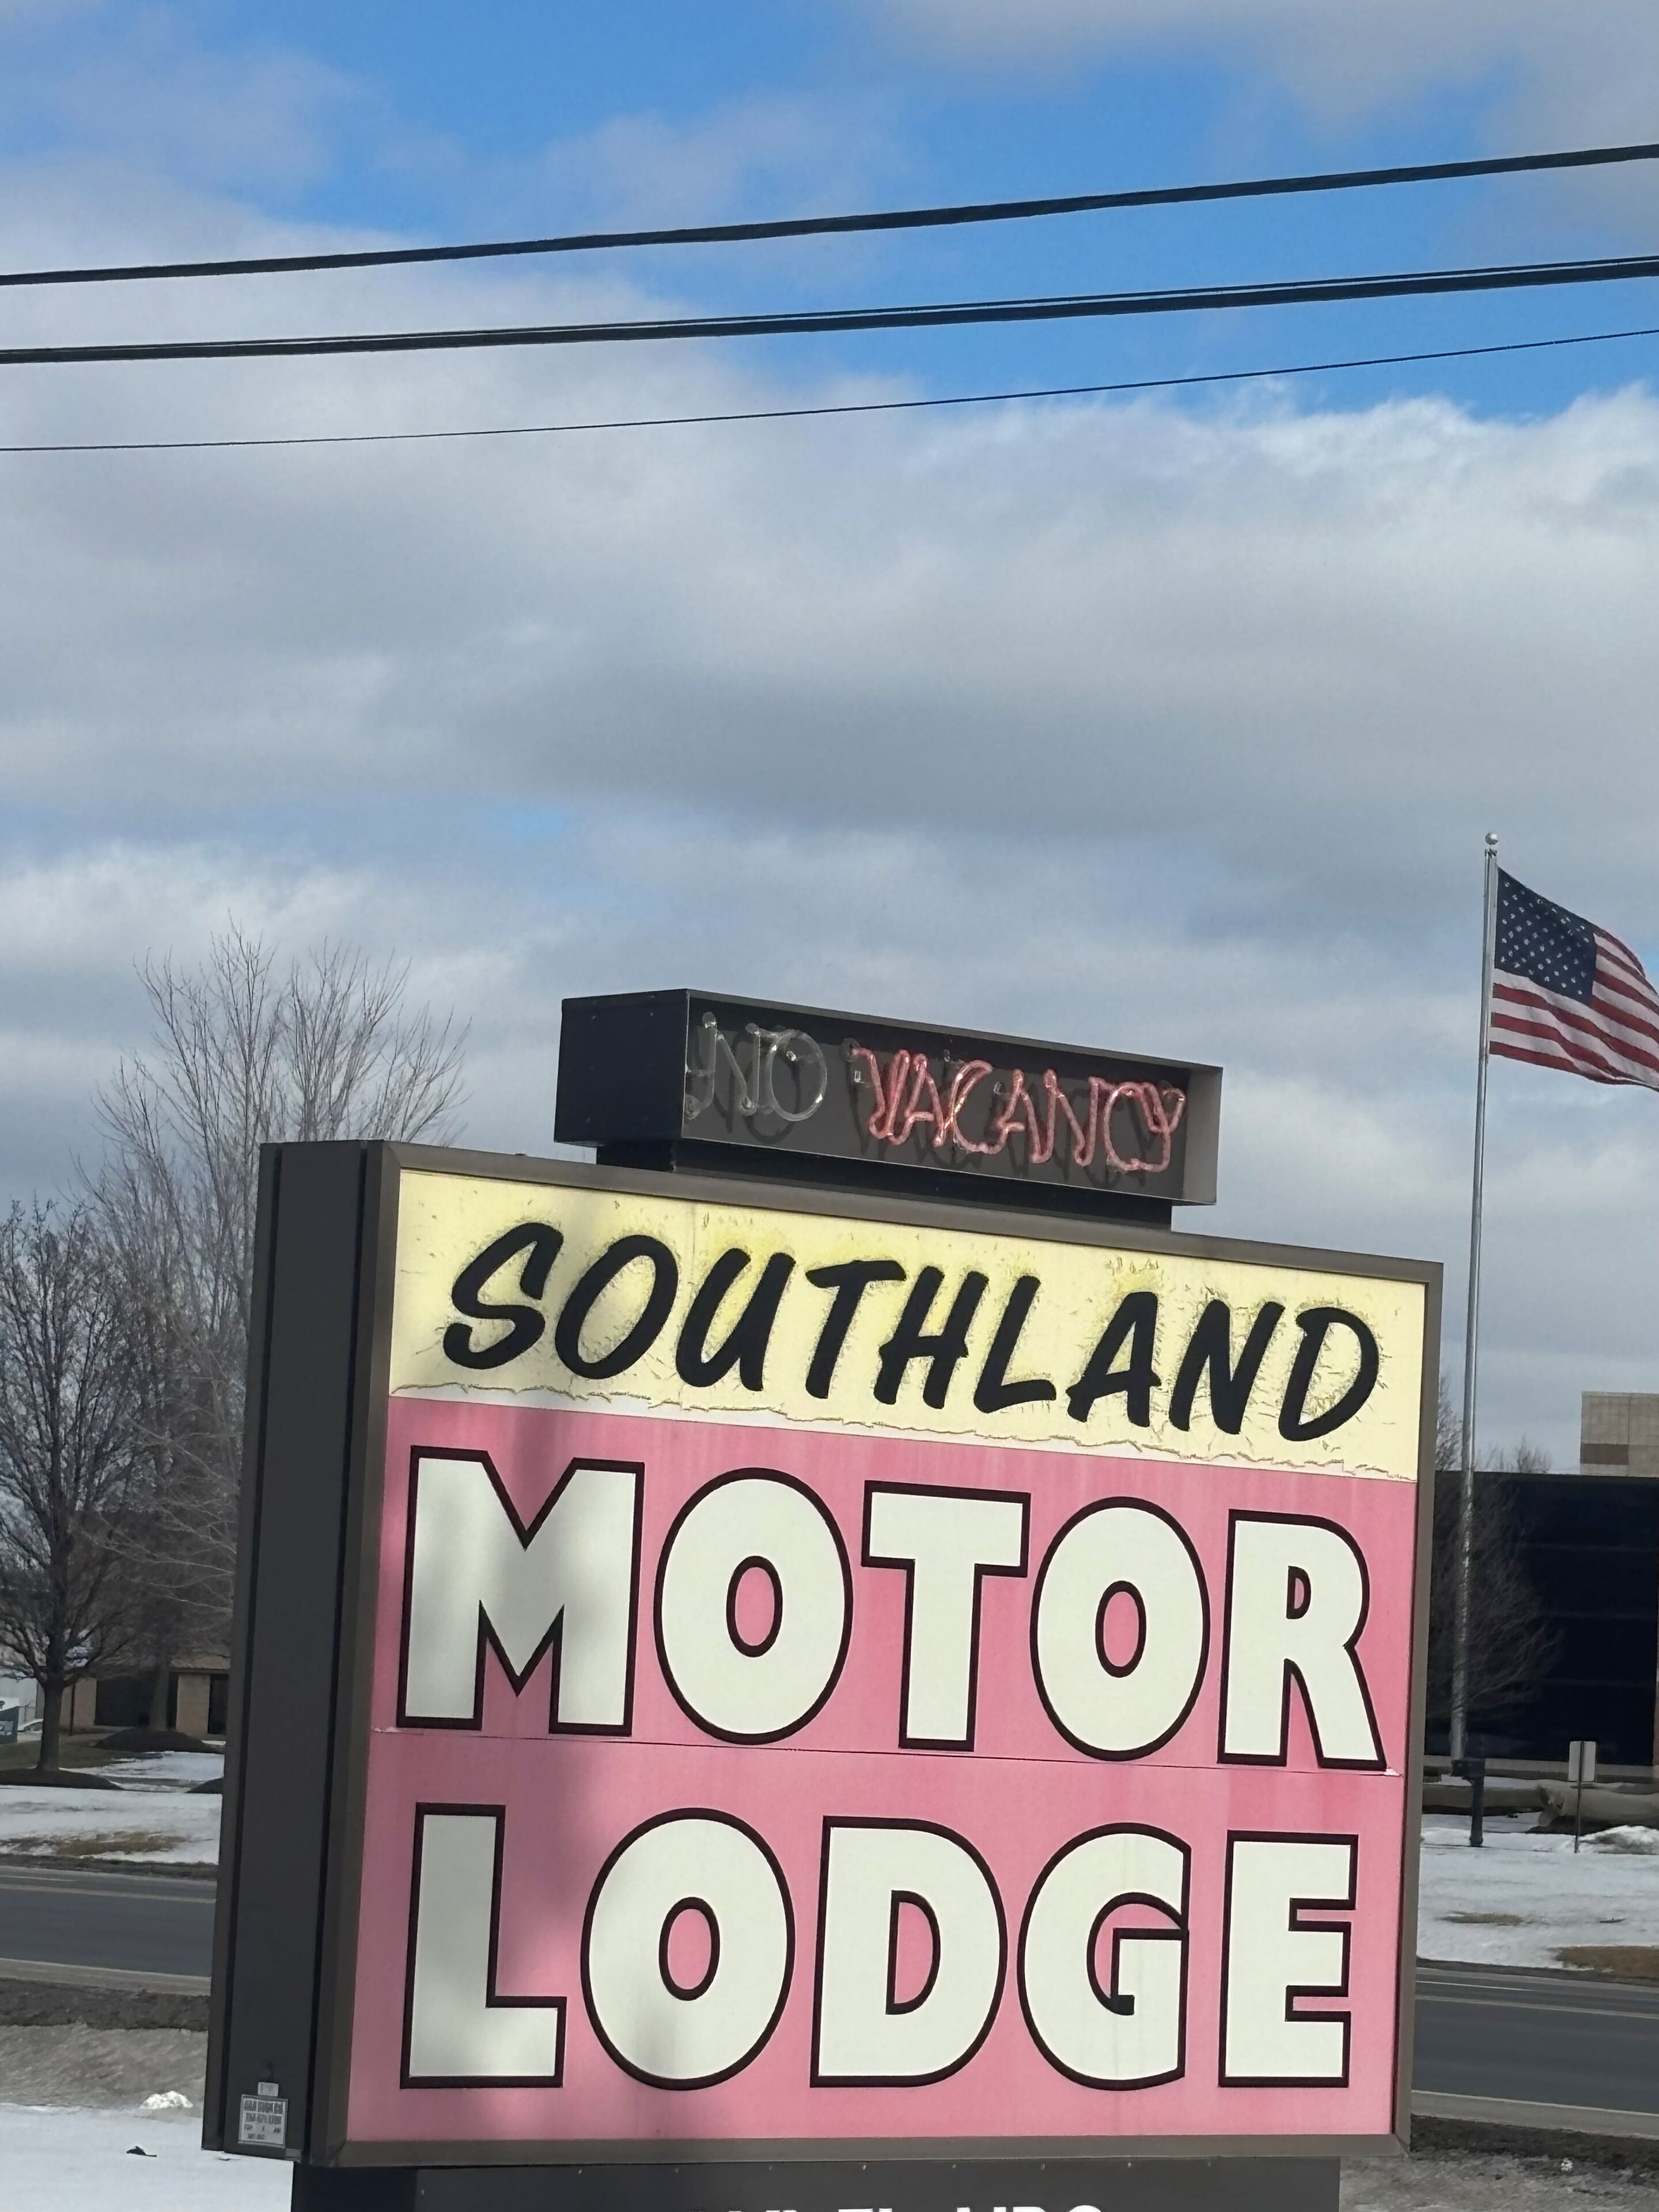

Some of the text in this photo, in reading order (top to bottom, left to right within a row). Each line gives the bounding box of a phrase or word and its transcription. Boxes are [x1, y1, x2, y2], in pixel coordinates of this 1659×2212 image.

[685, 1012, 1185, 1173] NO VACANCY
[441, 1221, 1381, 1442] SOUTHLAND
[397, 1445, 1387, 1771] MOTOR
[400, 1802, 1358, 2092] LODGE
